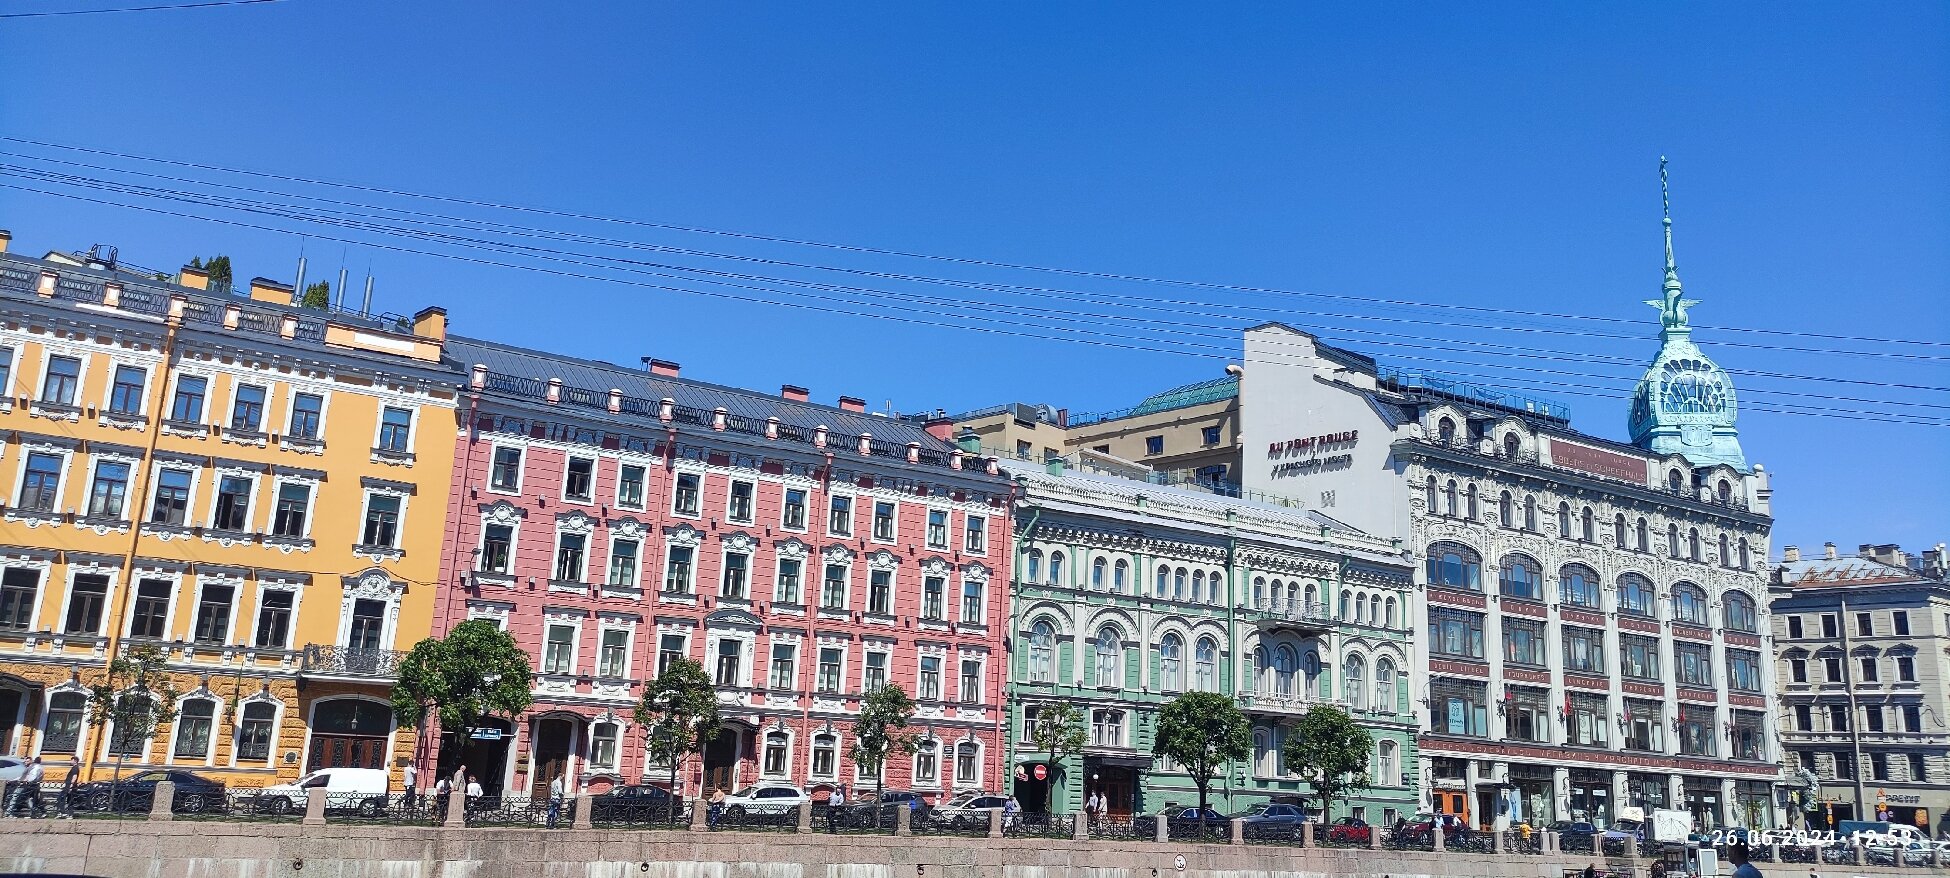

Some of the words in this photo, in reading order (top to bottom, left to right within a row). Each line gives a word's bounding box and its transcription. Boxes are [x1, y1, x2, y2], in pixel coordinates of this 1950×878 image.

[1269, 442, 1284, 453] AU
[1287, 436, 1317, 449] PONT
[1318, 430, 1359, 445] ROUGE
